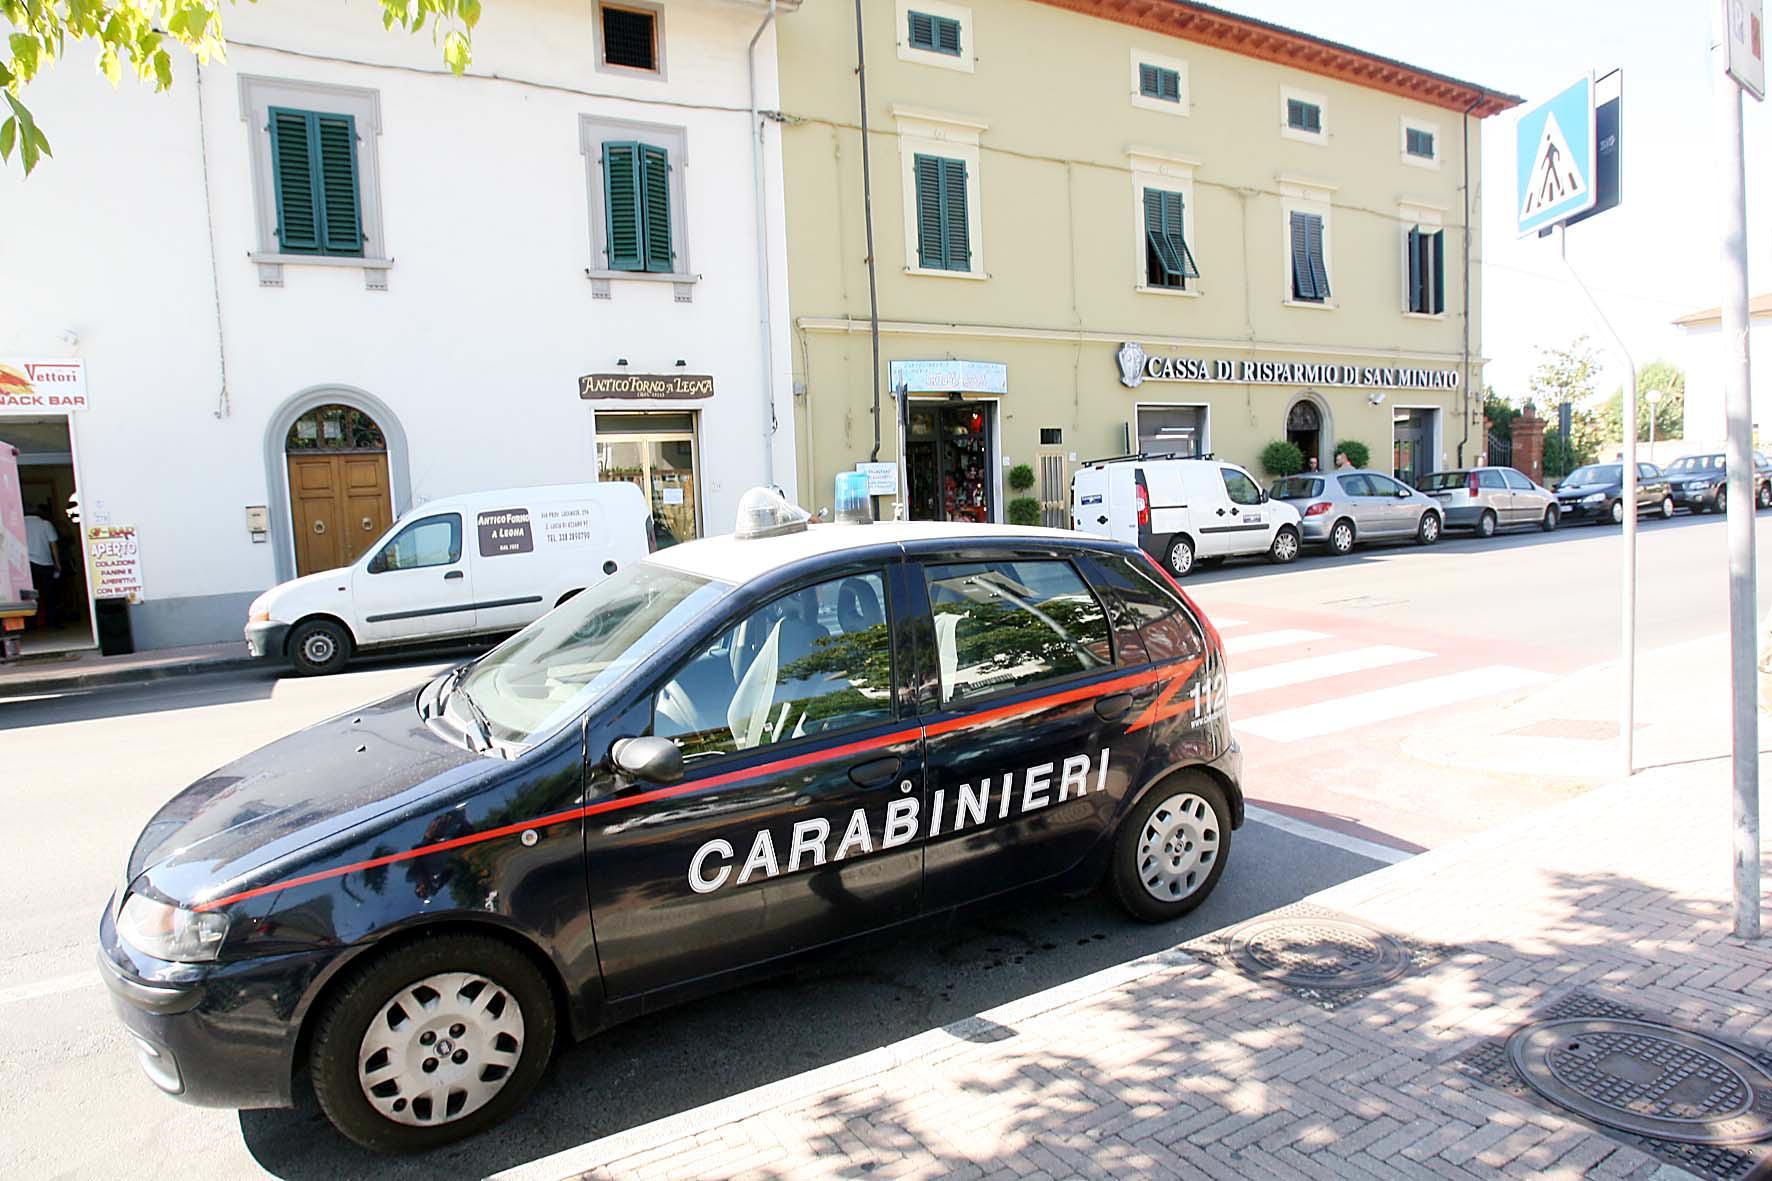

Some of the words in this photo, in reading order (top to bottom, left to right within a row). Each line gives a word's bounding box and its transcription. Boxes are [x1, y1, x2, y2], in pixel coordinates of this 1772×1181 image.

[24, 364, 77, 382] Vettori
[1148, 357, 1210, 379] CASSA
[1217, 359, 1236, 380] DI
[1243, 361, 1338, 385] RISPARMIO
[1342, 365, 1359, 386] DI
[1364, 367, 1394, 386] SAN
[1399, 368, 1460, 388] MINIATO
[48, 396, 85, 405] BAR
[478, 515, 506, 526] ANTICO
[506, 514, 530, 524] FORNO
[491, 530, 497, 539] A
[91, 542, 137, 559] APERTO
[96, 559, 136, 567] COLAZIONI
[1189, 673, 1225, 718] 112
[688, 748, 1110, 894] CARABINIERI
